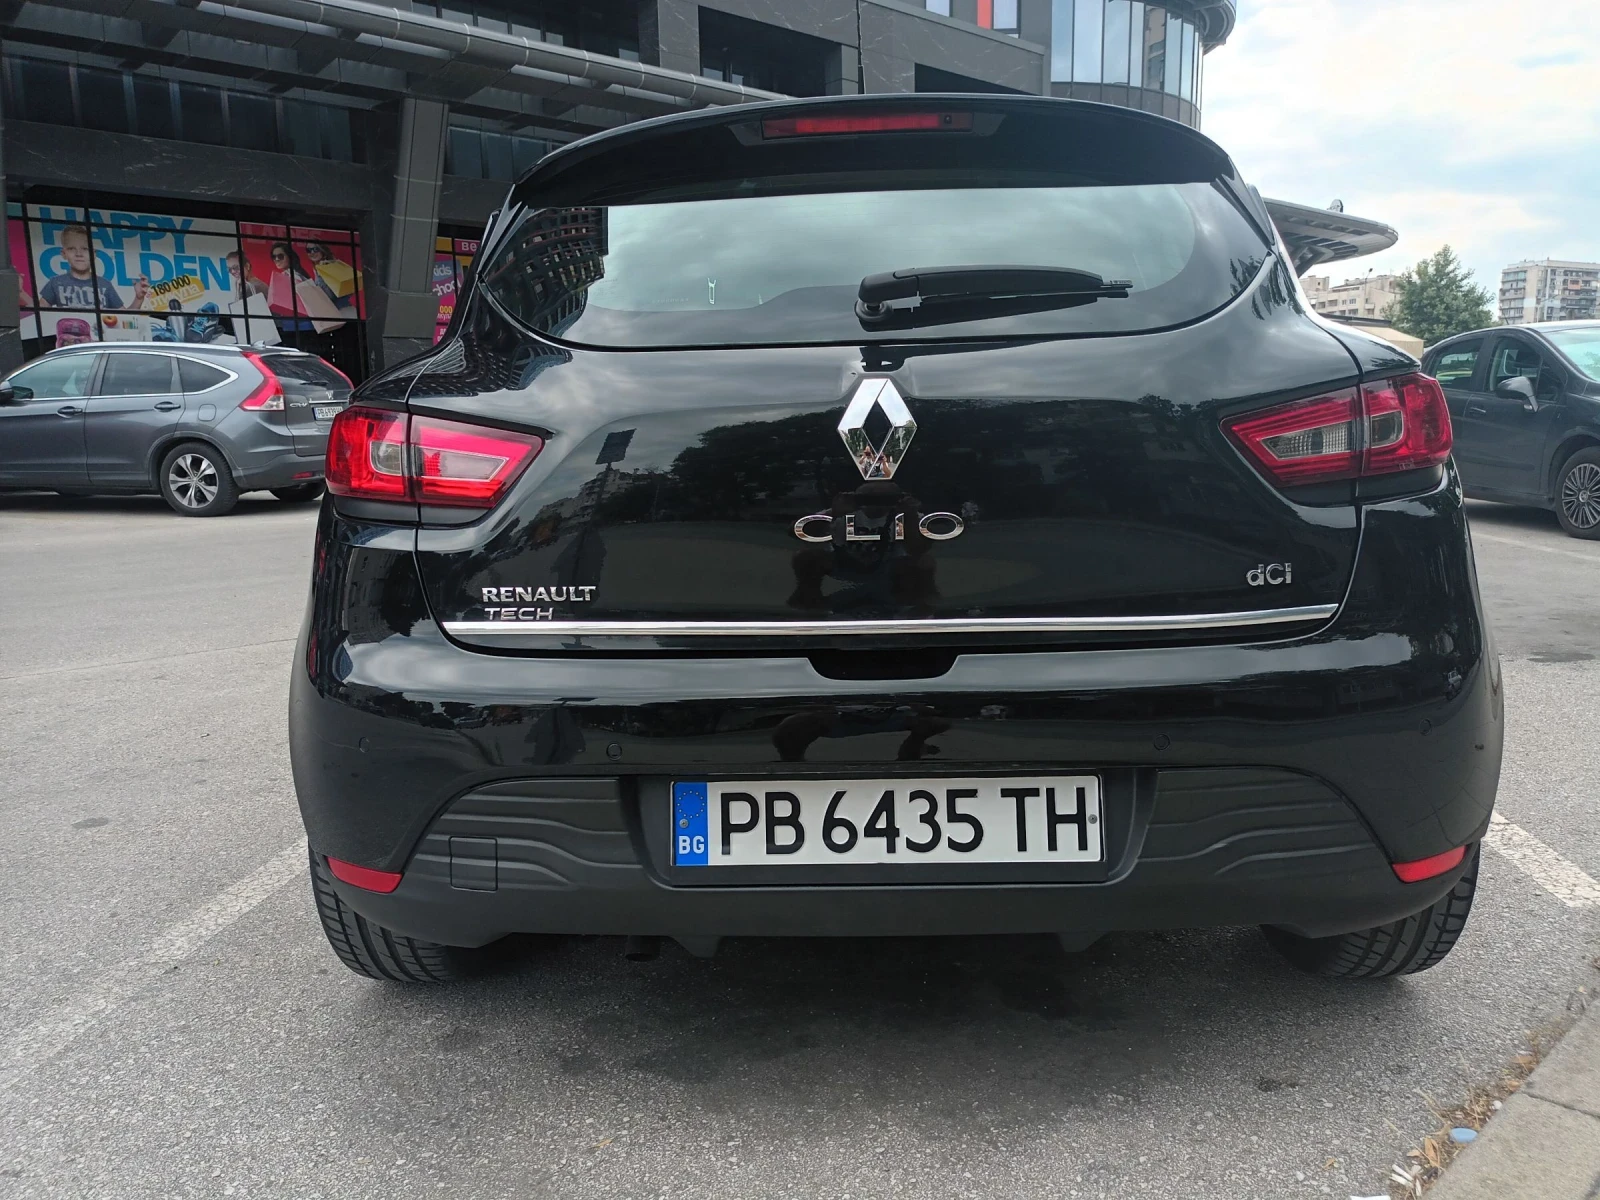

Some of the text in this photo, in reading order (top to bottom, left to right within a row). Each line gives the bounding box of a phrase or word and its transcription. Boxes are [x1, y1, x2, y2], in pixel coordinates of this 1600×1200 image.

[39, 206, 193, 254] HAPPY
[39, 246, 231, 291] GOLDEN
[151, 275, 191, 296] 180 000
[793, 512, 964, 543] CLIO
[1246, 563, 1292, 586] dCi
[481, 585, 597, 602] RENAULT
[484, 607, 554, 620] TECH
[720, 786, 1089, 856] PB 6435 TH
[678, 835, 705, 854] BG
